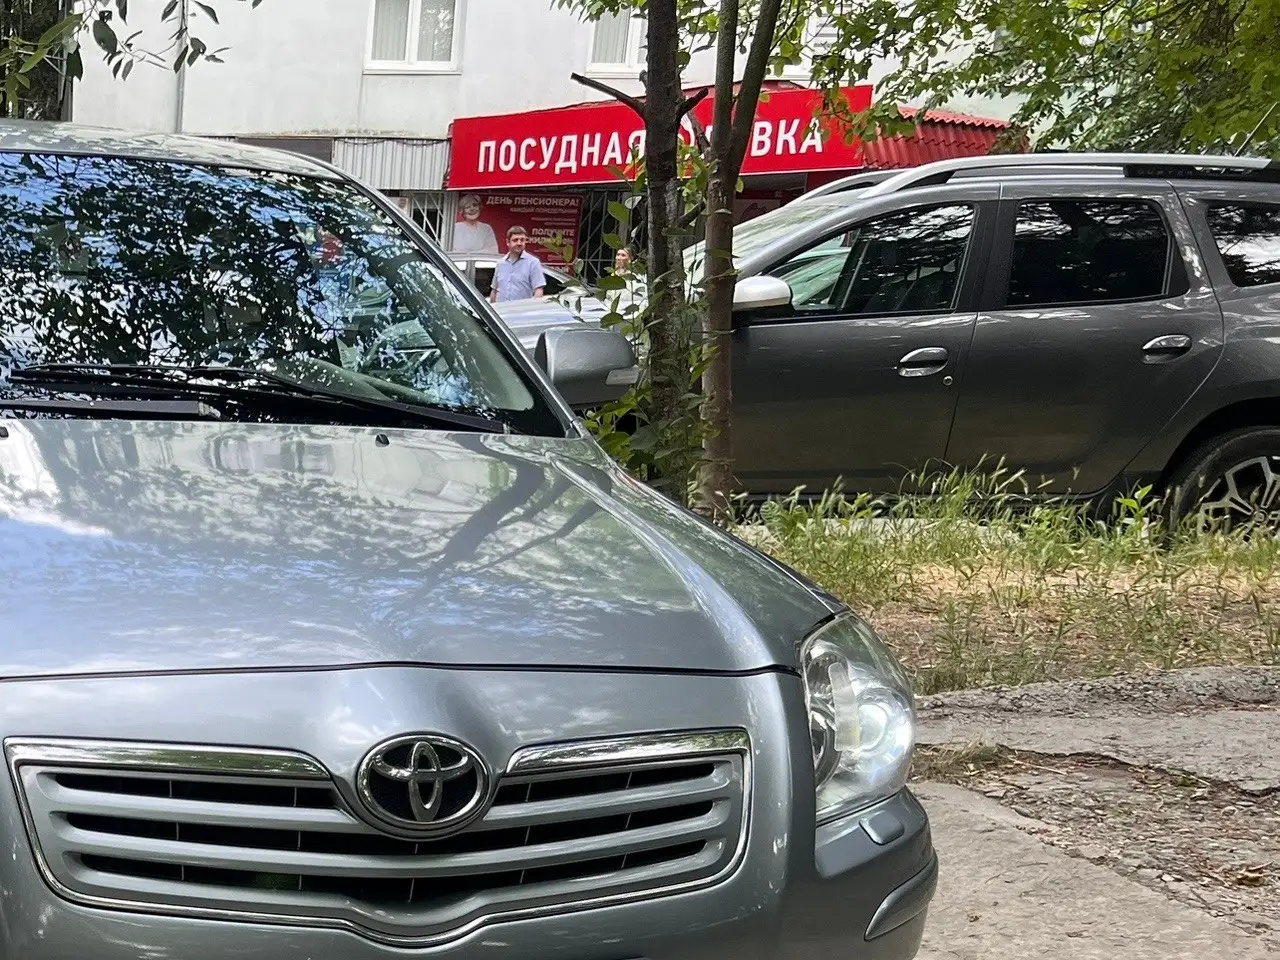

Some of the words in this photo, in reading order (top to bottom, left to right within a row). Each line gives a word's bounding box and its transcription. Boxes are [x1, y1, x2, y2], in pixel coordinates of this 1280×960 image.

[478, 129, 648, 174] ПОСУДНАЯ
[486, 195, 513, 205] ДЕНЬ
[514, 197, 579, 207] ПЕНСИОНЕРА!
